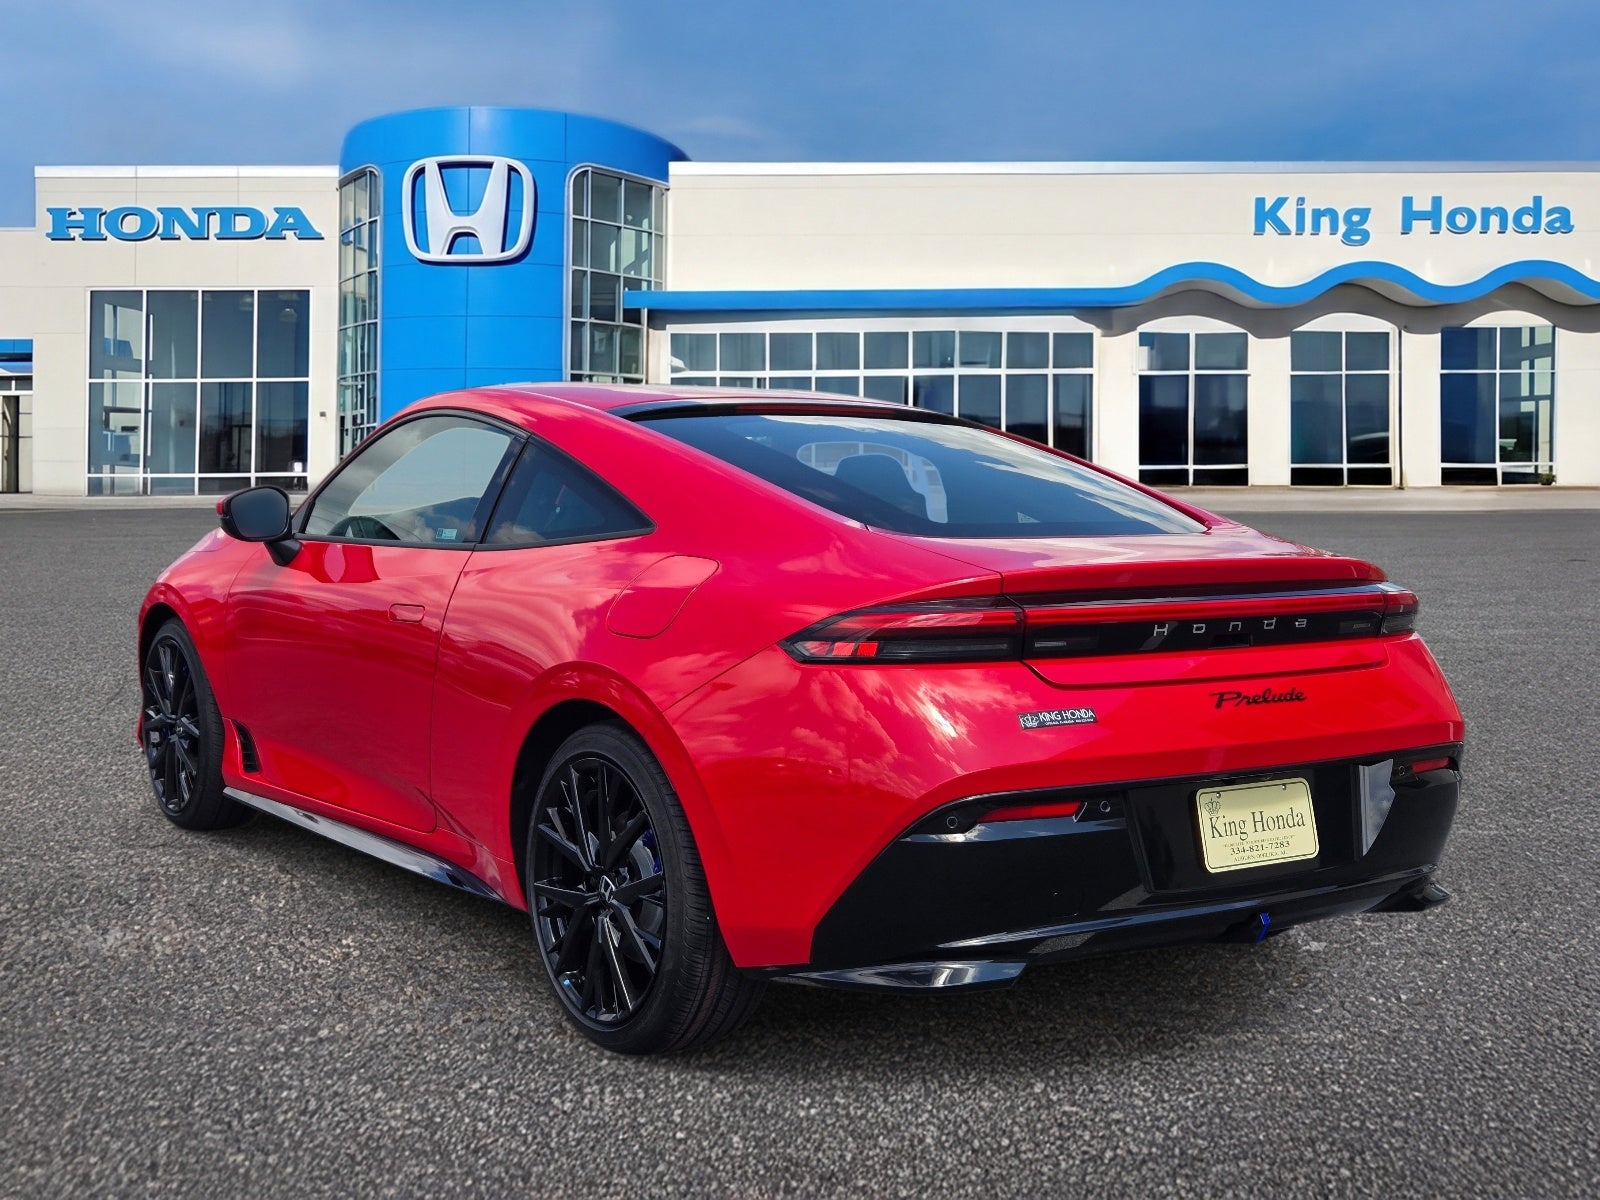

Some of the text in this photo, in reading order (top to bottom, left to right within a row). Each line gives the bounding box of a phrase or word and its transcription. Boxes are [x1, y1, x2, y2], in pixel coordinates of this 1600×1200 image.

[45, 205, 324, 242] HONDA
[1253, 195, 1575, 246] King Honda
[1209, 687, 1308, 709] Prelude
[1038, 711, 1061, 722] KING
[1061, 708, 1096, 719] HONDA
[1209, 815, 1249, 841] King
[1250, 807, 1306, 833] Honda
[1230, 840, 1290, 855] 334-821-7283
